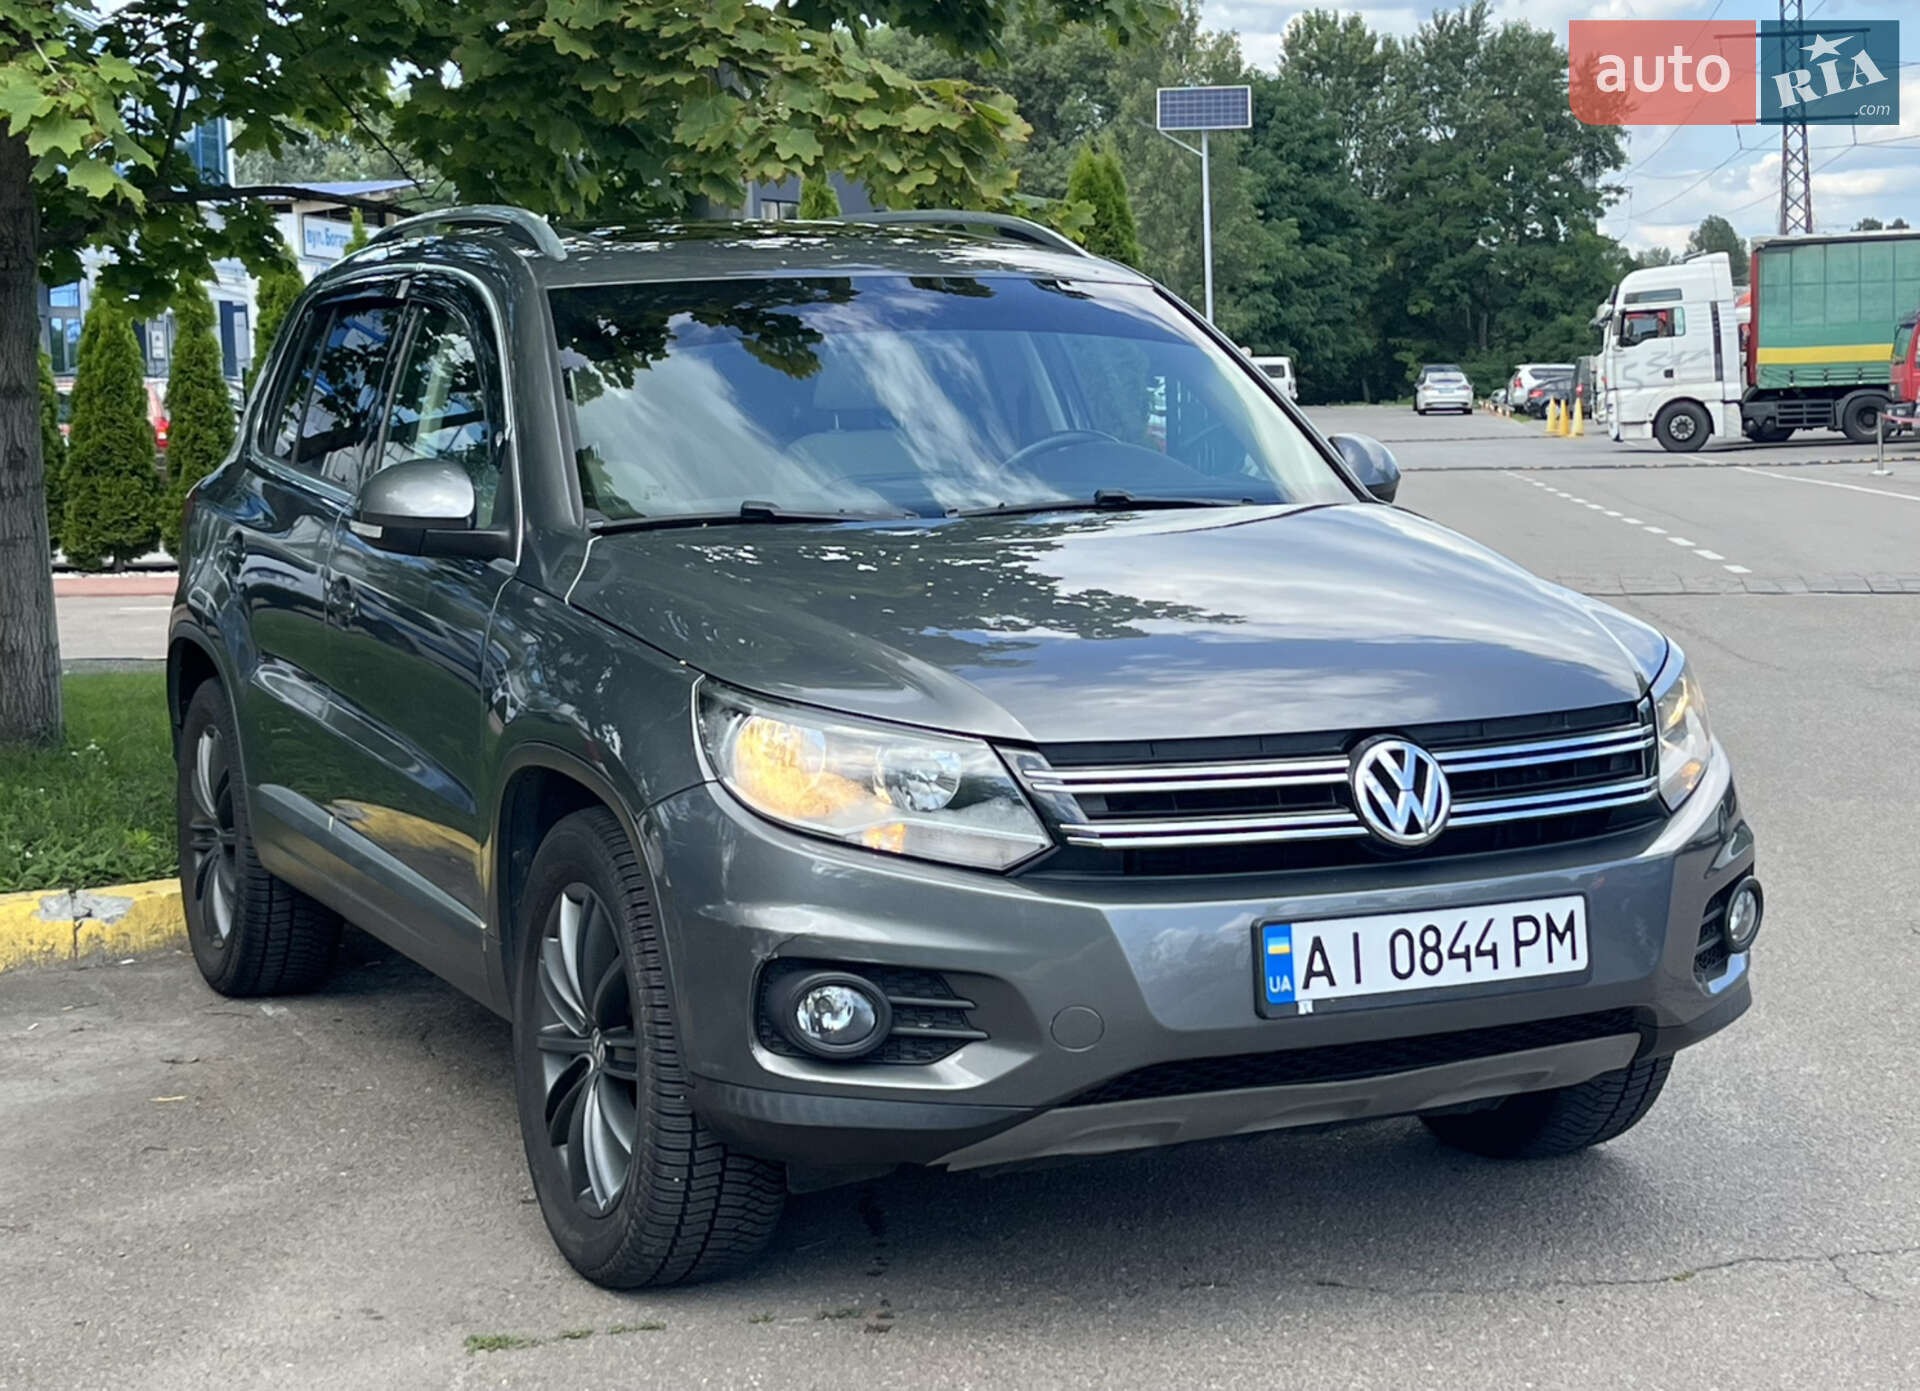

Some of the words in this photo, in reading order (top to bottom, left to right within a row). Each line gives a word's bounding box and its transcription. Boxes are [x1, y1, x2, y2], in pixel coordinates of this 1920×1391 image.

[1389, 918, 1498, 980] 0844
[1513, 909, 1577, 968] PM
[1269, 975, 1293, 992] UA
